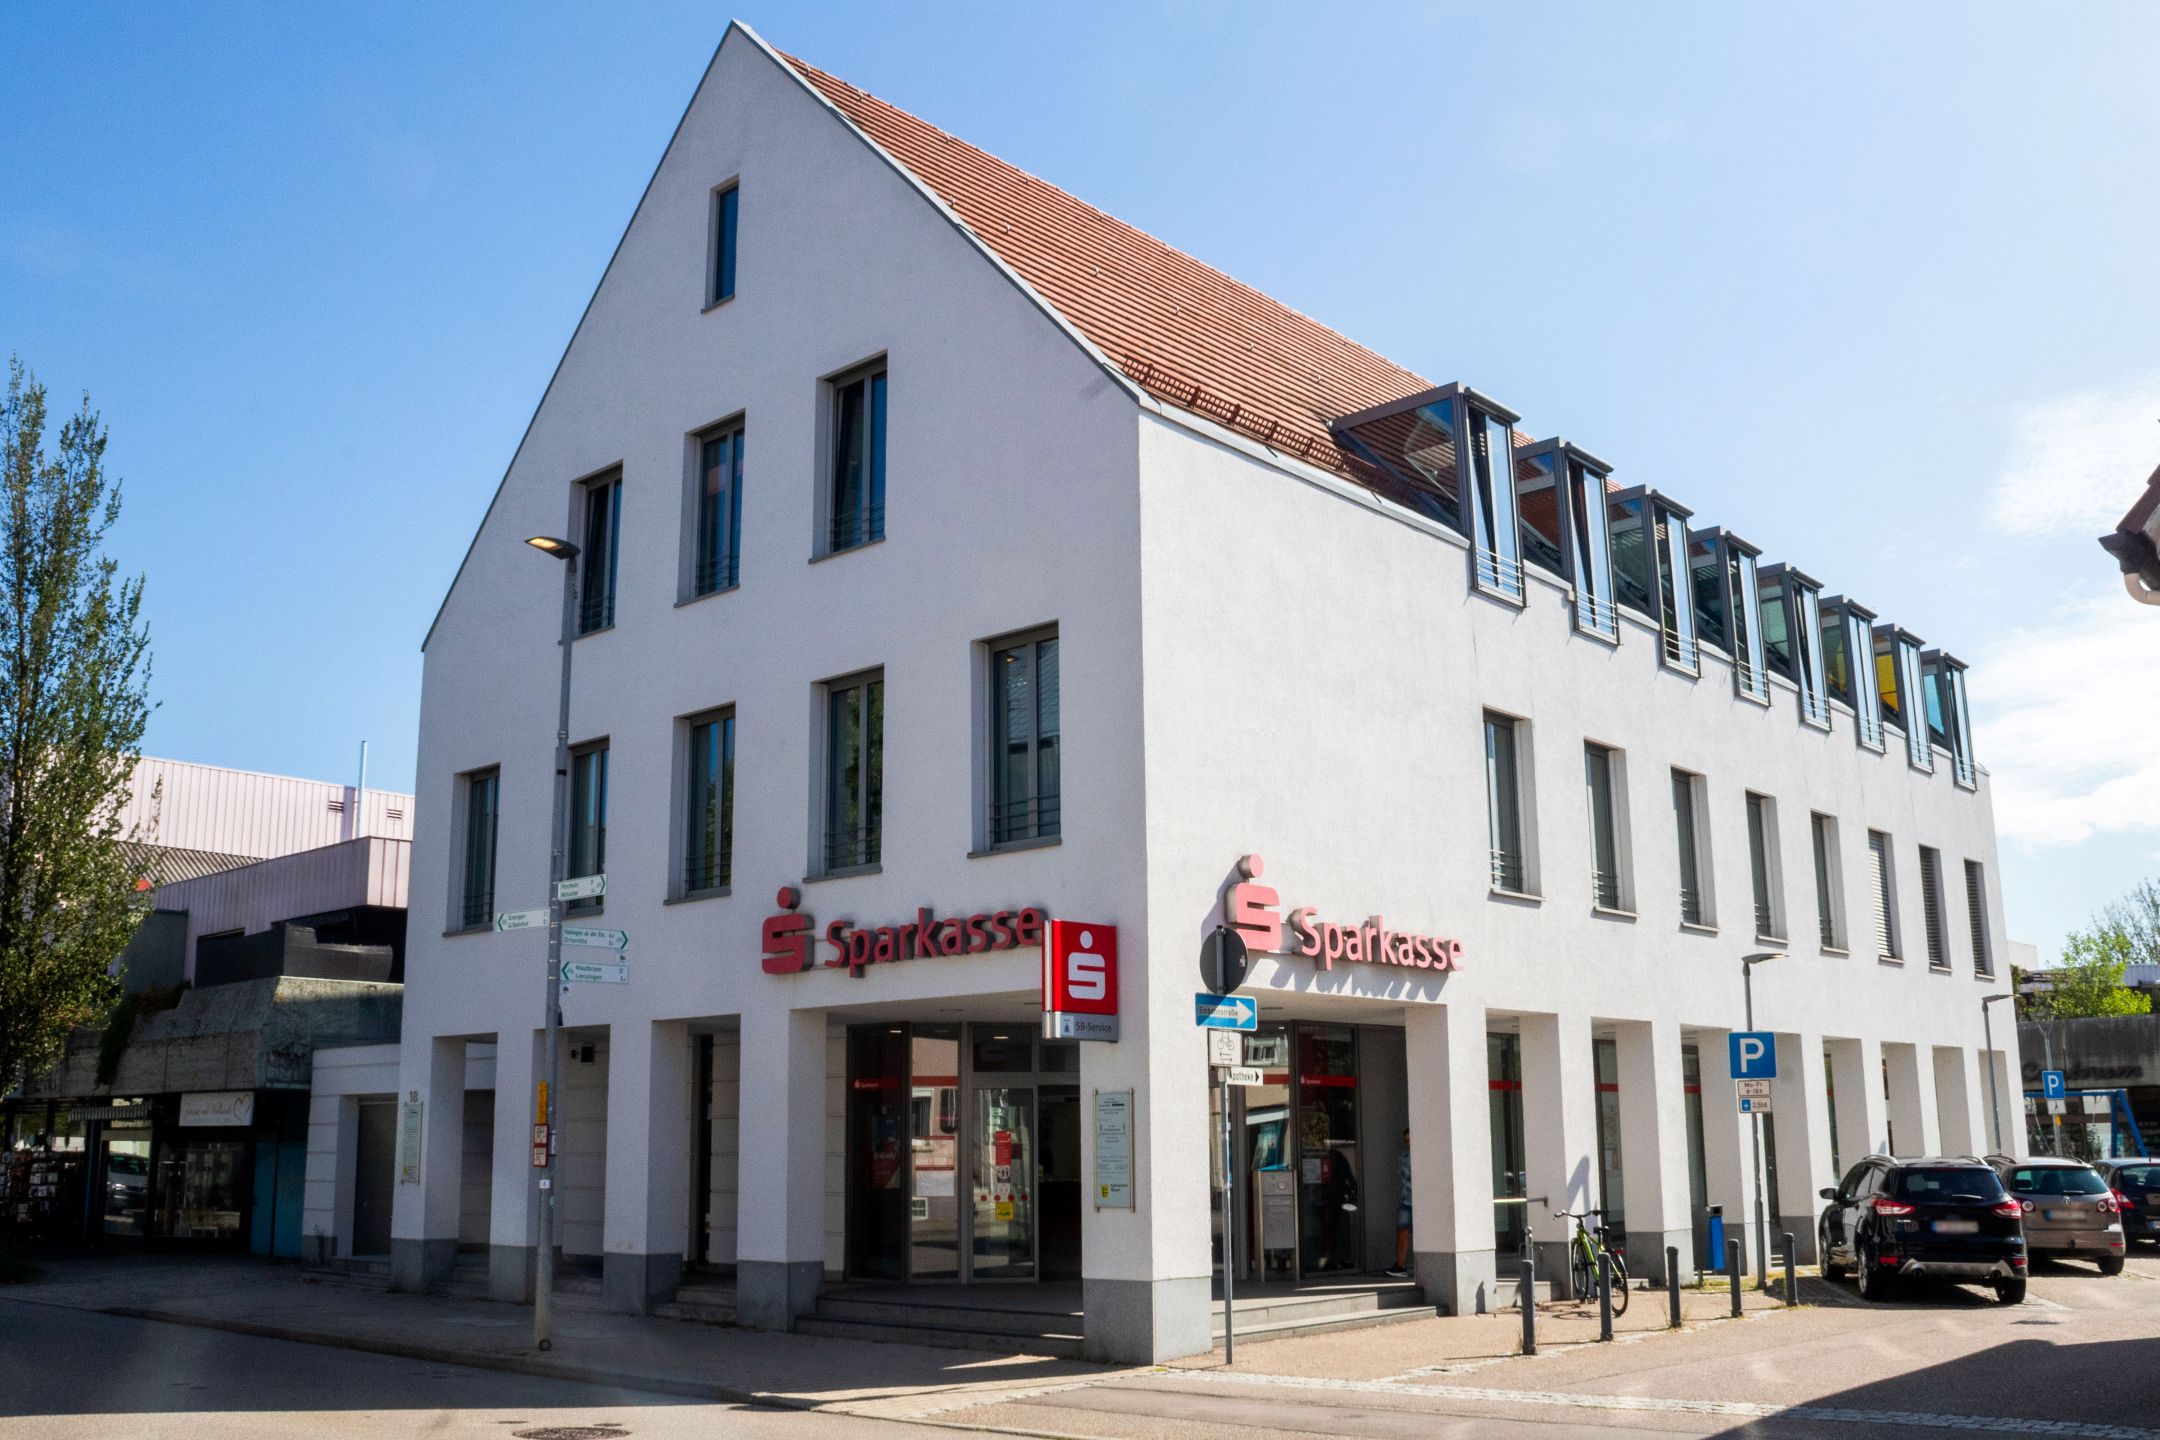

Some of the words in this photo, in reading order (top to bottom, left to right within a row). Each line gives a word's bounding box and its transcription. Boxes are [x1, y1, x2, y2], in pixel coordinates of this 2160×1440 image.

[824, 907, 1047, 978] Sparkasse
[1293, 906, 1465, 972] Sparkasse
[1199, 1005, 1239, 1017] Einbahnstraße
[1074, 1021, 1112, 1033] SB-Service
[1740, 1038, 1765, 1073] P
[2047, 1074, 2059, 1096] P
